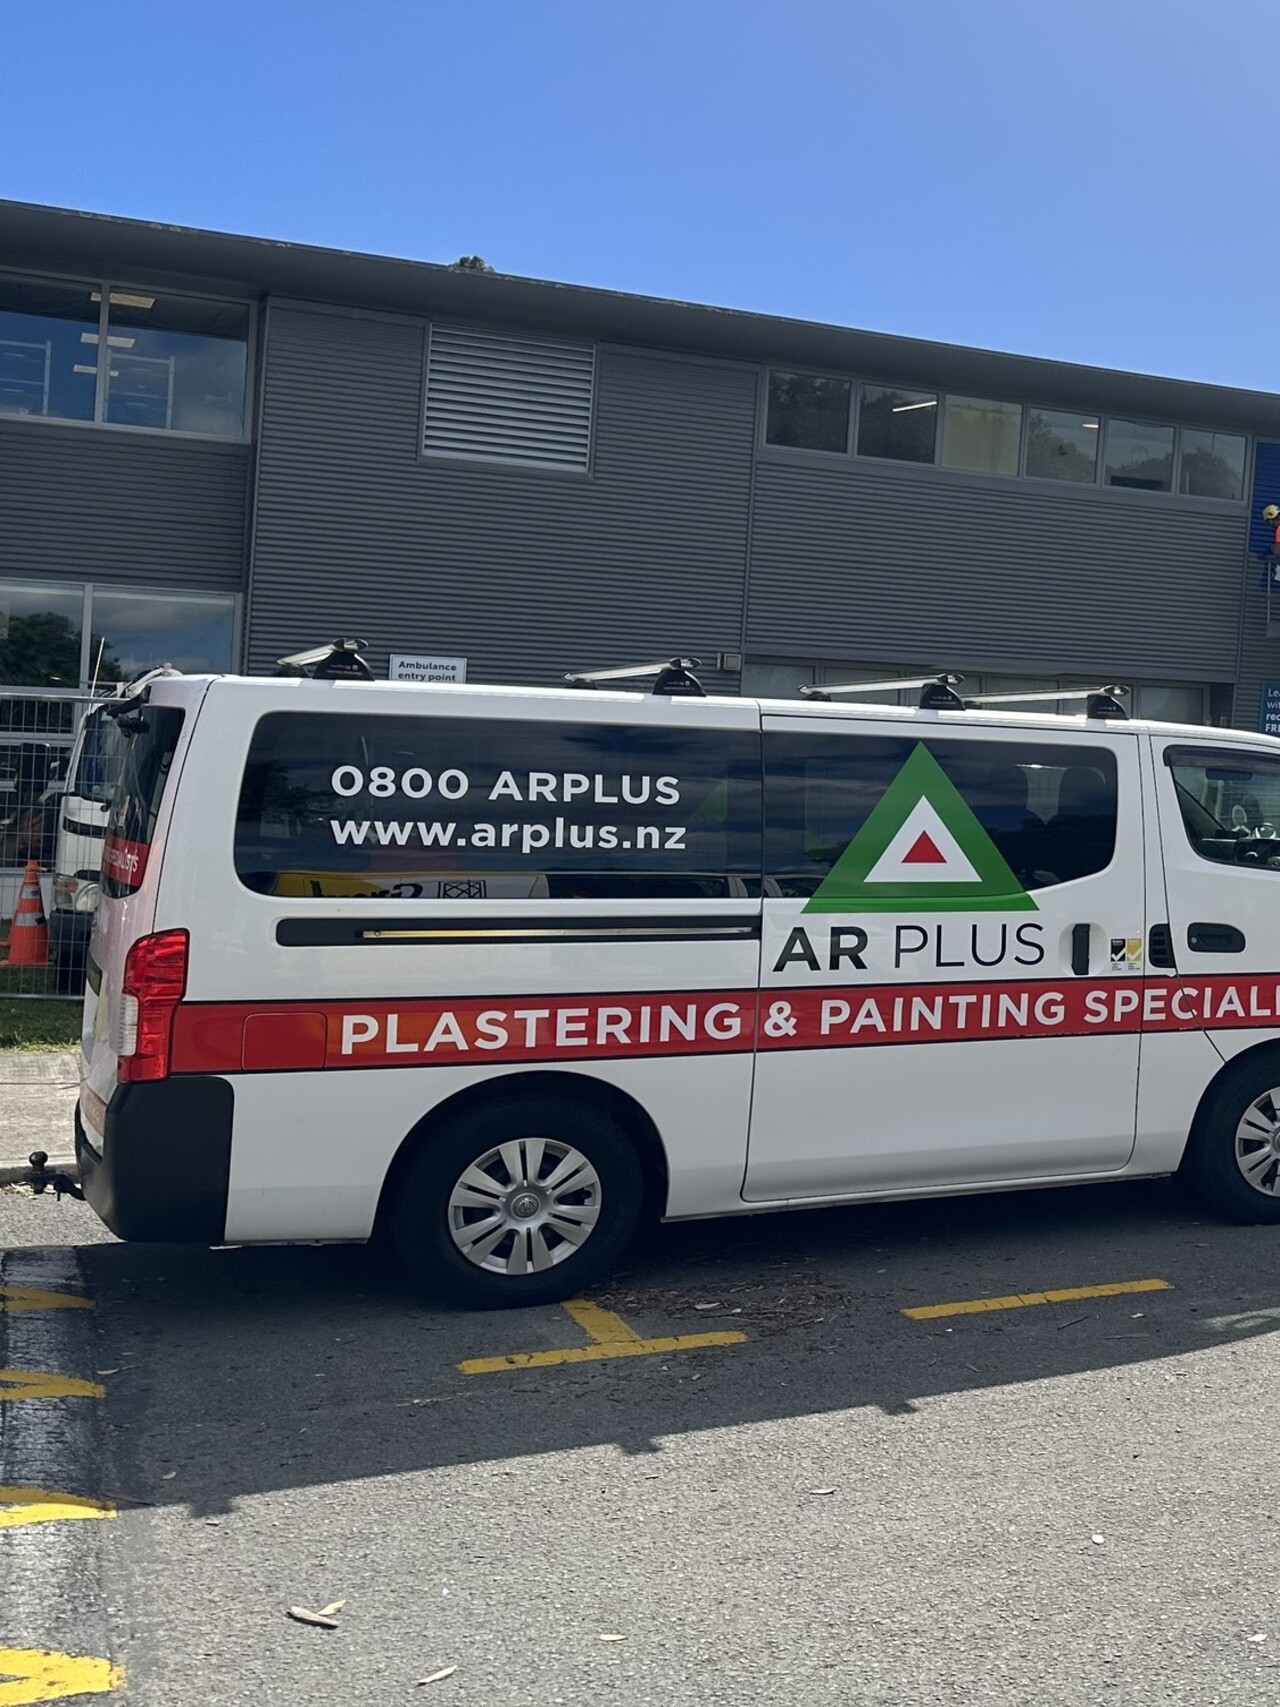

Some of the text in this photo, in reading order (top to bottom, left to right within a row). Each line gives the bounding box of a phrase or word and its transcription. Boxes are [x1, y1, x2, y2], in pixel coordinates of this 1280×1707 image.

[398, 660, 457, 671] Ambulance
[398, 672, 456, 682] entry point
[331, 765, 681, 806] 0800 ARPLUS
[330, 816, 687, 854] www.arplus.nz
[773, 922, 1046, 973] AR PLUS
[341, 1002, 742, 1056] PLASTERING
[763, 1000, 797, 1038] &
[820, 991, 1067, 1035] PAINTING
